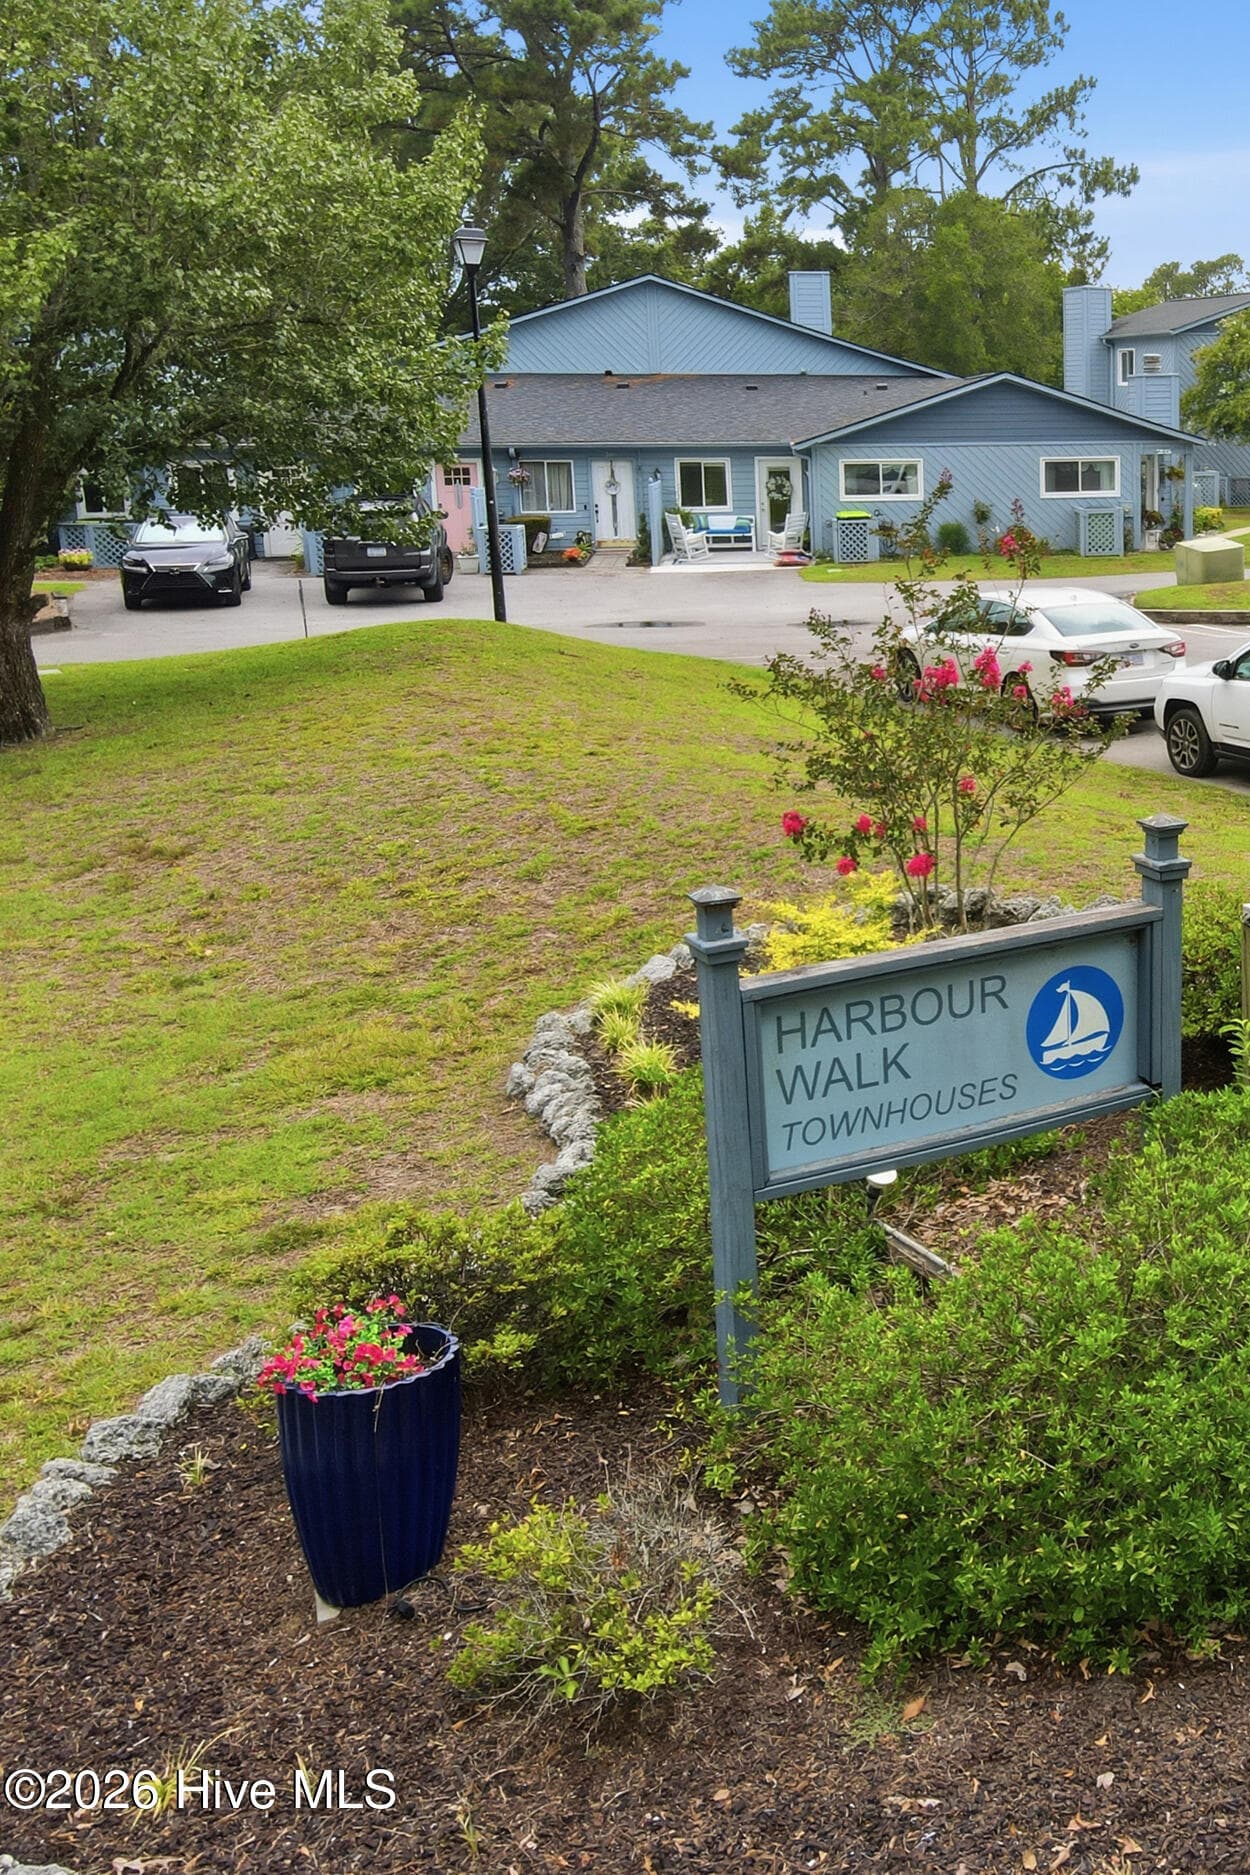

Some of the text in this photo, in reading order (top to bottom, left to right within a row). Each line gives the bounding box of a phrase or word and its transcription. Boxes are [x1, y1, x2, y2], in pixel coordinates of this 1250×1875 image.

[776, 974, 1009, 1054] HARBOUR
[775, 1042, 912, 1105] WALK
[782, 1073, 1018, 1152] TOWNHOUSES
